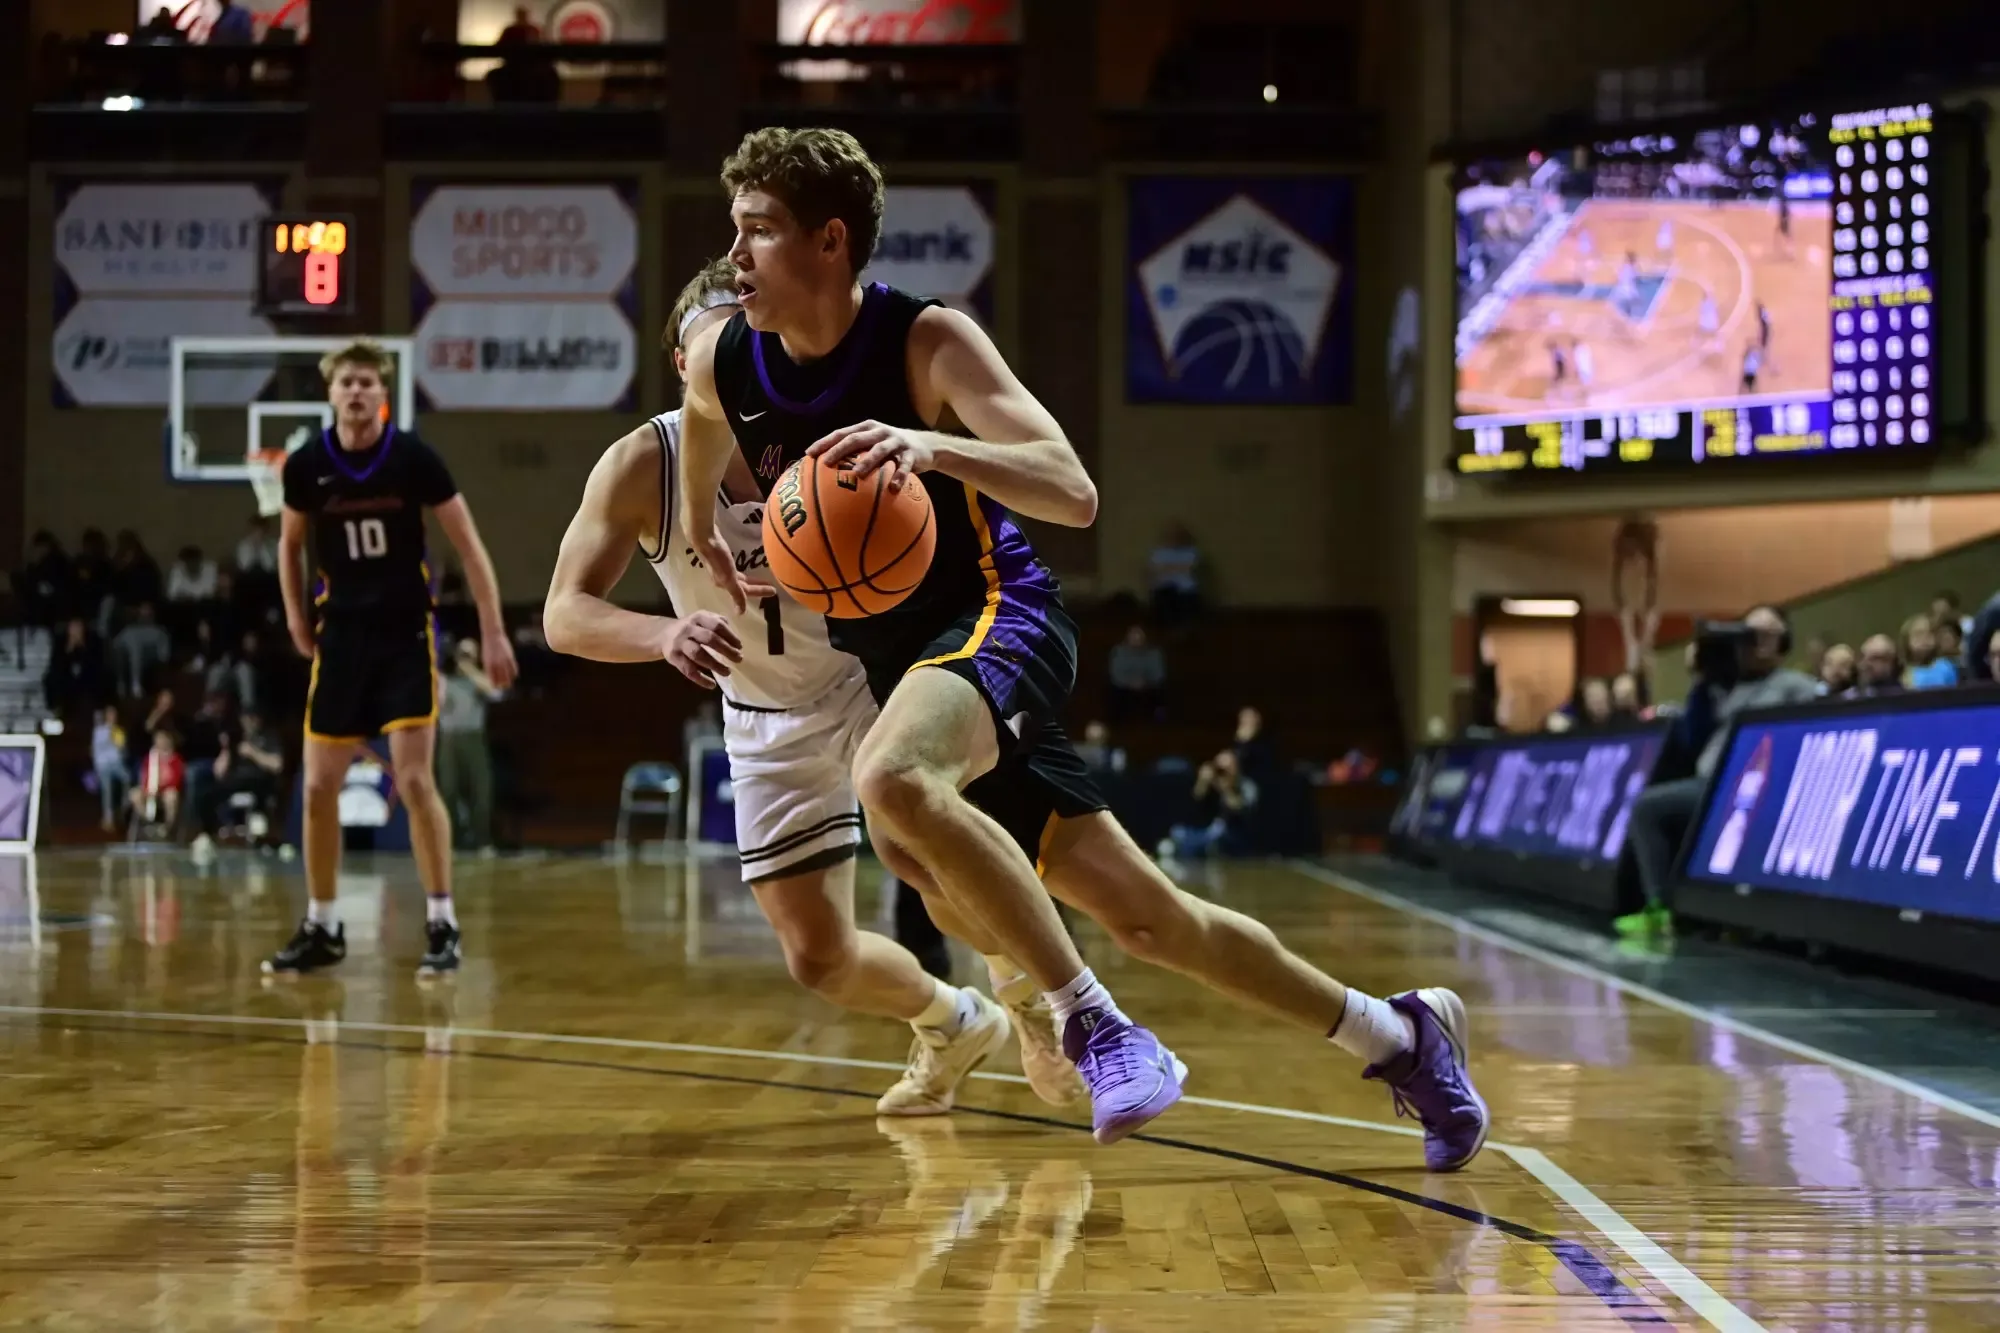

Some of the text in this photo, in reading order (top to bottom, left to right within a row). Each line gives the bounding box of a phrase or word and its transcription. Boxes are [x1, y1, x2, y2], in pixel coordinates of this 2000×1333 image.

[453, 206, 586, 240] MIDCO
[305, 251, 338, 305] 8
[452, 242, 601, 279] SPORTS
[344, 518, 388, 560] 10
[759, 594, 785, 655] 1
[1850, 747, 1983, 876] TIME
